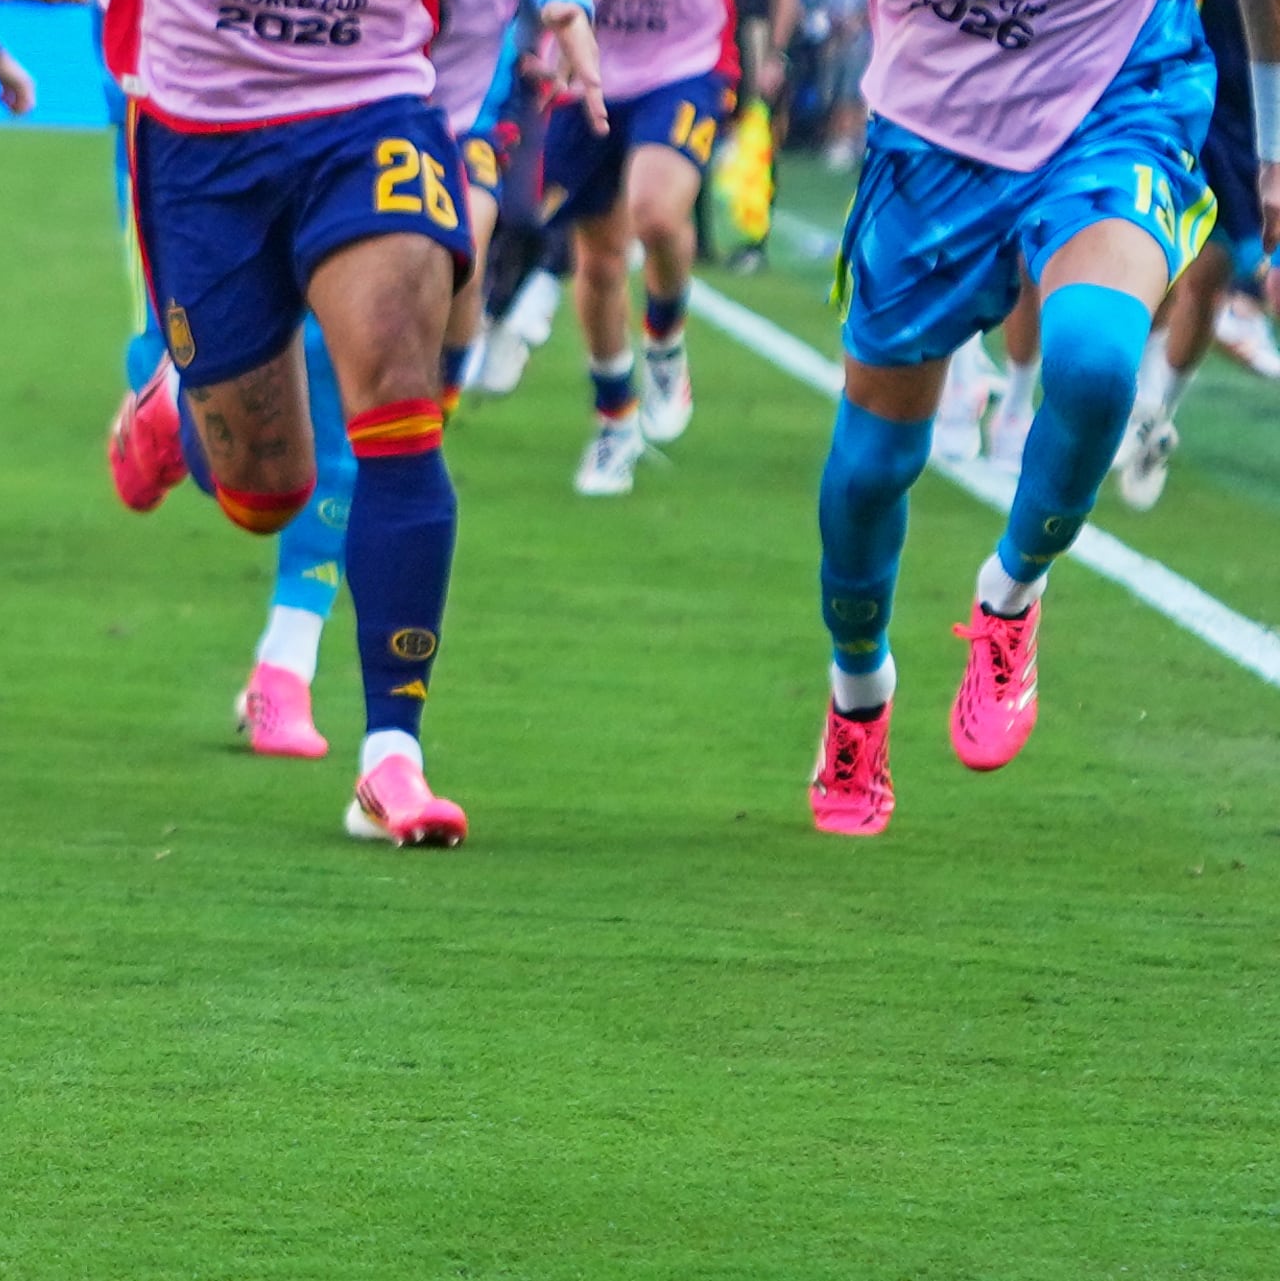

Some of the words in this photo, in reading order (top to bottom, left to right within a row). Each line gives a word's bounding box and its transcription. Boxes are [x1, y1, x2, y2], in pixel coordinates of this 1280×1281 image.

[215, 5, 362, 47] 2026
[669, 100, 719, 164] 14
[374, 136, 458, 230] 26
